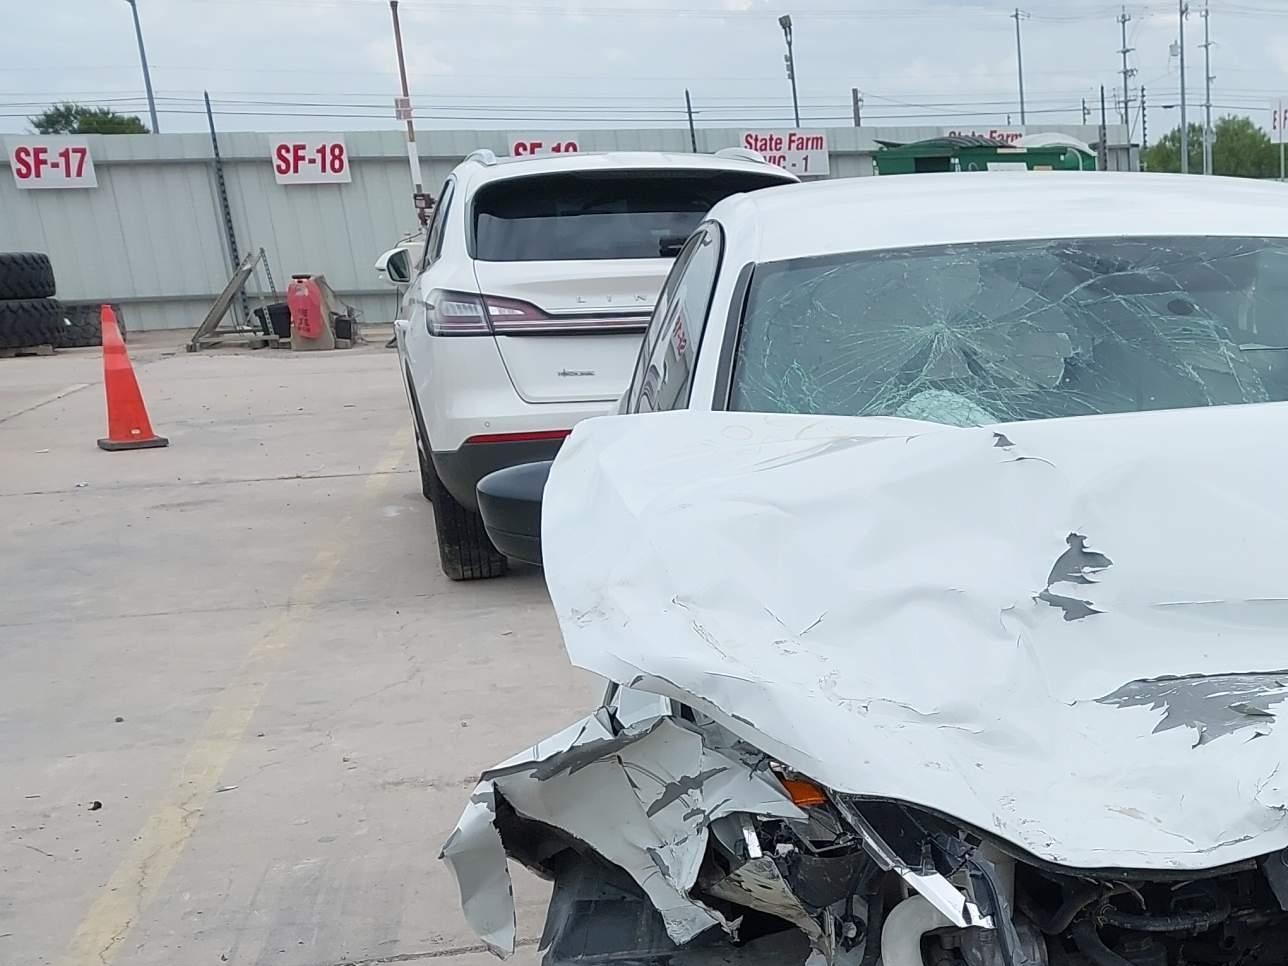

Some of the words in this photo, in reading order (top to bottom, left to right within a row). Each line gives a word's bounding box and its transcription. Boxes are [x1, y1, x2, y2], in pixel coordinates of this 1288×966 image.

[744, 133, 783, 151] State
[788, 133, 824, 151] Farm
[15, 147, 87, 178] SF-17
[276, 143, 344, 174] SF-18
[802, 155, 809, 172] 1
